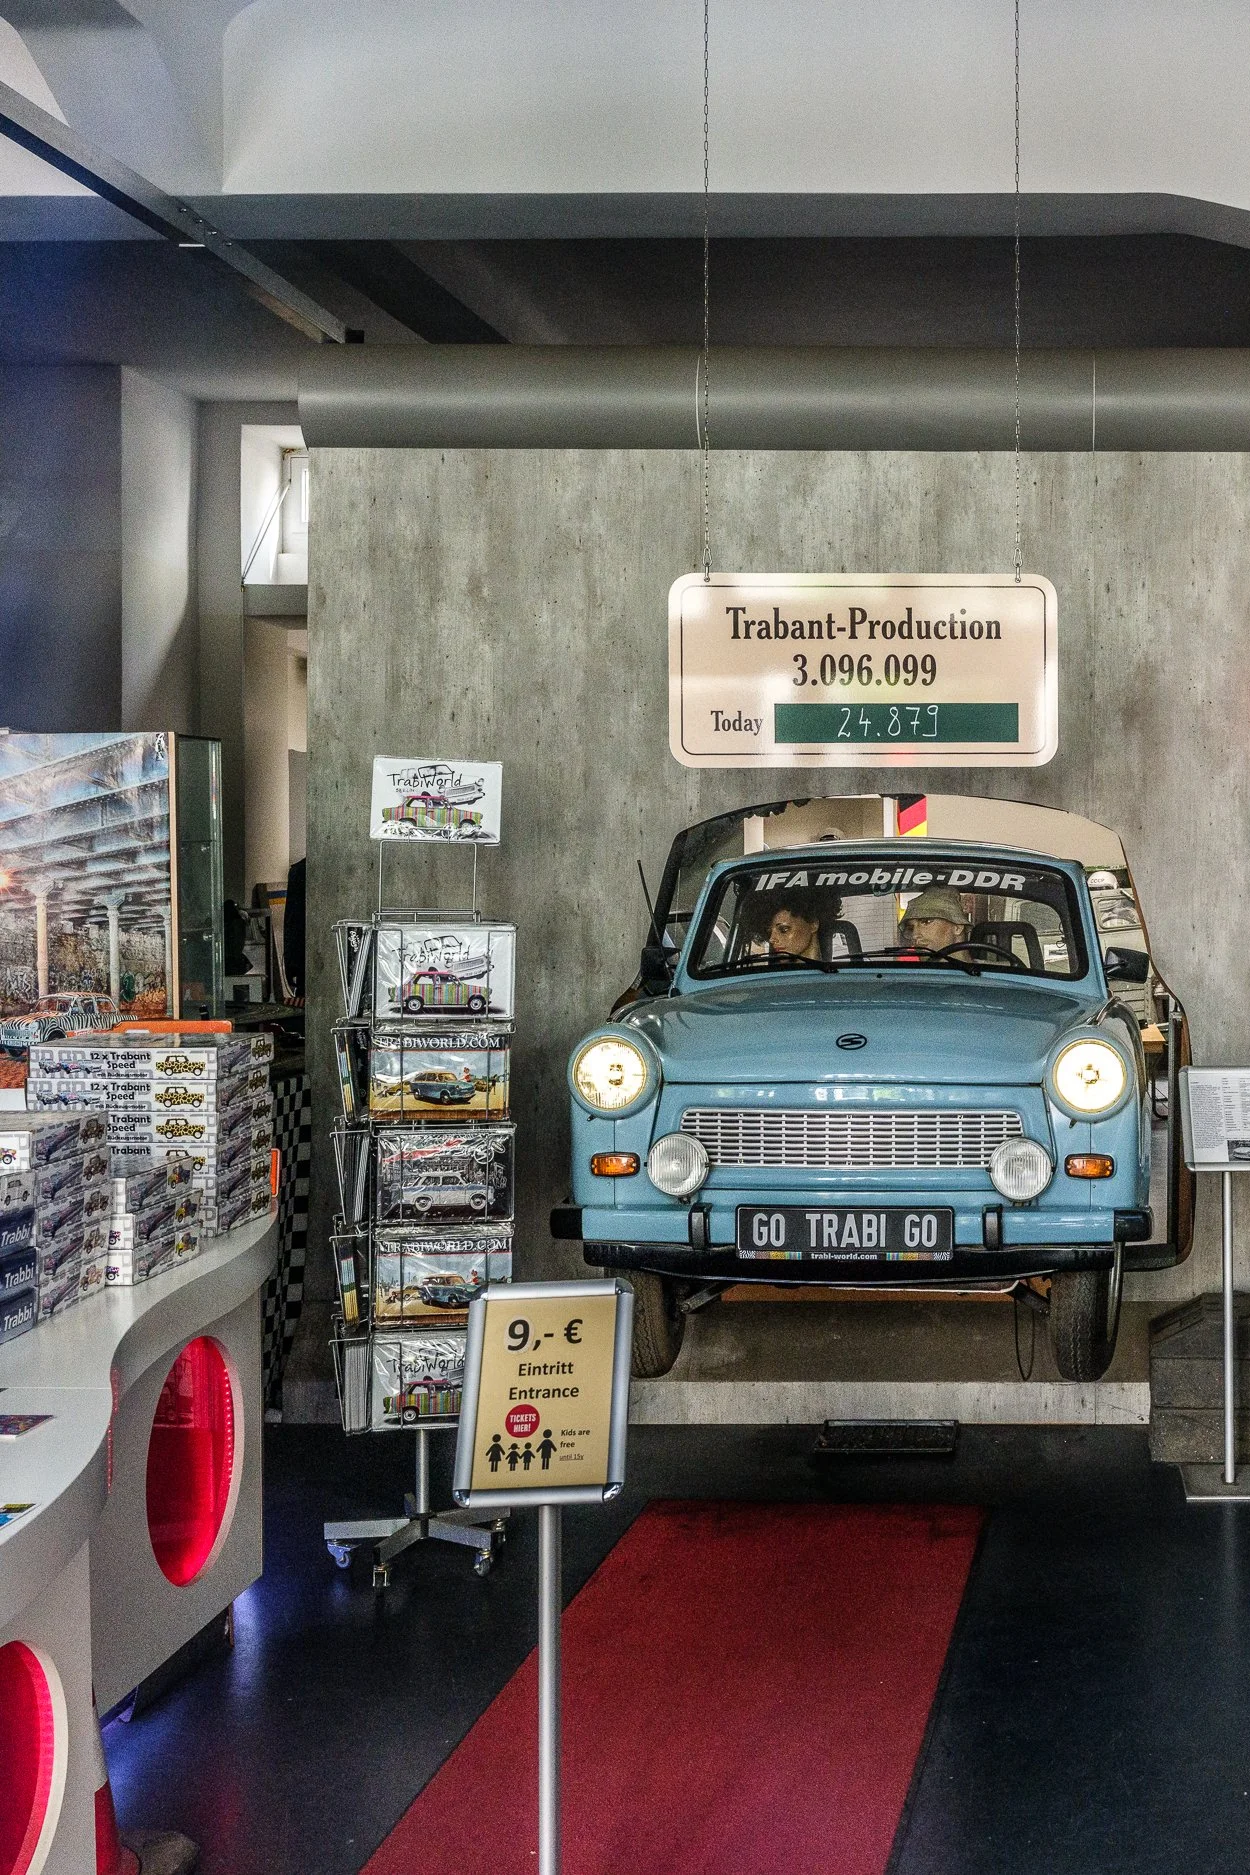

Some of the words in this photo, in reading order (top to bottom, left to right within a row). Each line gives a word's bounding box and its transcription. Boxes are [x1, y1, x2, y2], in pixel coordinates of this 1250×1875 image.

[726, 606, 1002, 640] Trabant-Production
[792, 653, 937, 686] 3.096.099
[710, 710, 764, 736] Today
[837, 704, 940, 738] 24.879
[755, 870, 808, 892] IFA
[110, 1052, 151, 1060] Trabant
[107, 1061, 136, 1070] Speed
[110, 1082, 151, 1091] Trabant
[106, 1092, 135, 1100] Speed
[110, 1114, 151, 1123] Trabant
[107, 1124, 136, 1132] Speed
[111, 1146, 151, 1155] Trabant
[1, 1222, 32, 1247] Trabbi
[752, 1212, 786, 1248] GO
[805, 1213, 886, 1248] TRABI
[904, 1214, 938, 1248] GO
[811, 1252, 878, 1260] trabi-world.com
[5, 1262, 34, 1289] Trabbi
[4, 1302, 32, 1332] Trabbi
[564, 1318, 583, 1344] €
[518, 1361, 574, 1377] Eintritt
[509, 1386, 580, 1400] Entrance
[509, 1413, 536, 1423] TICKETS
[514, 1424, 531, 1433] HIER!
[561, 1429, 576, 1437] Kids
[560, 1440, 575, 1448] free
